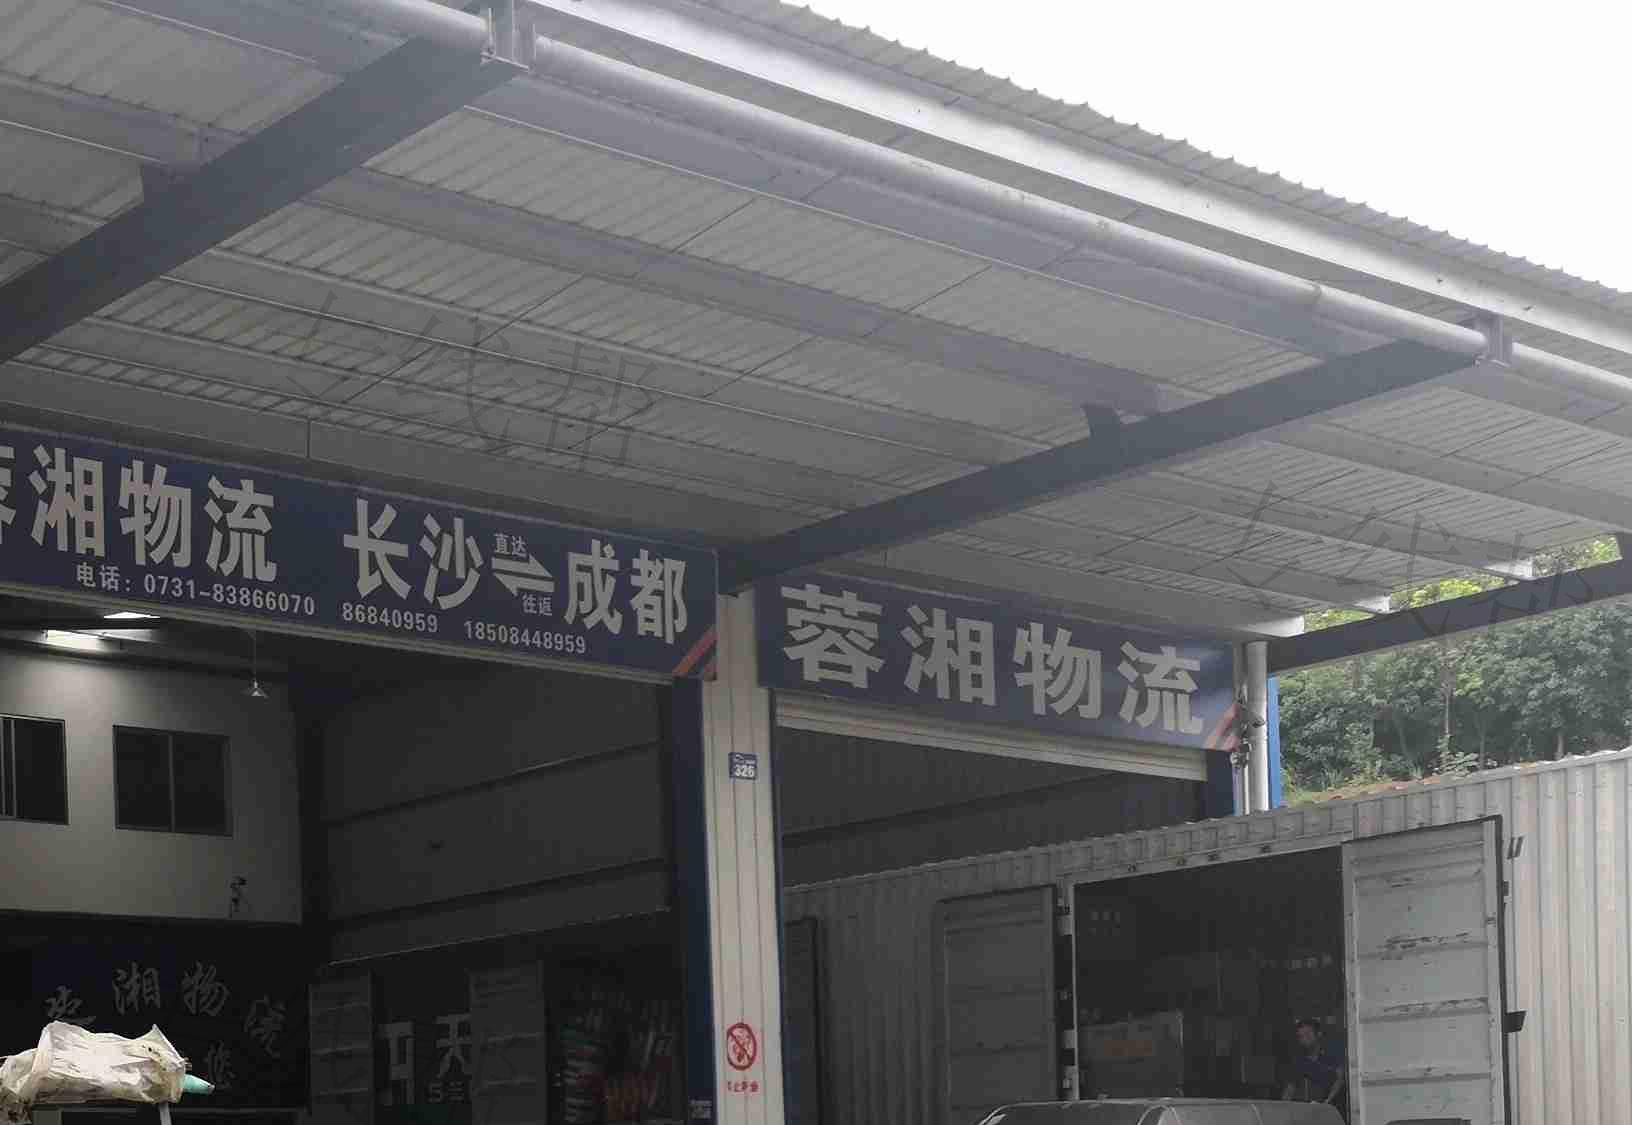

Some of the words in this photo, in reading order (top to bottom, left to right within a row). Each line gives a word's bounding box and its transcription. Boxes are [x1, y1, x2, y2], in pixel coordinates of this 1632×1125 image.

[342, 497, 484, 611] 长沙
[563, 538, 688, 645] 成都
[493, 532, 528, 558] 直达
[341, 601, 440, 634] 86840959
[463, 620, 587, 655] 18508448959
[521, 594, 555, 619] 往返
[781, 583, 1207, 735] 蓉湘物流
